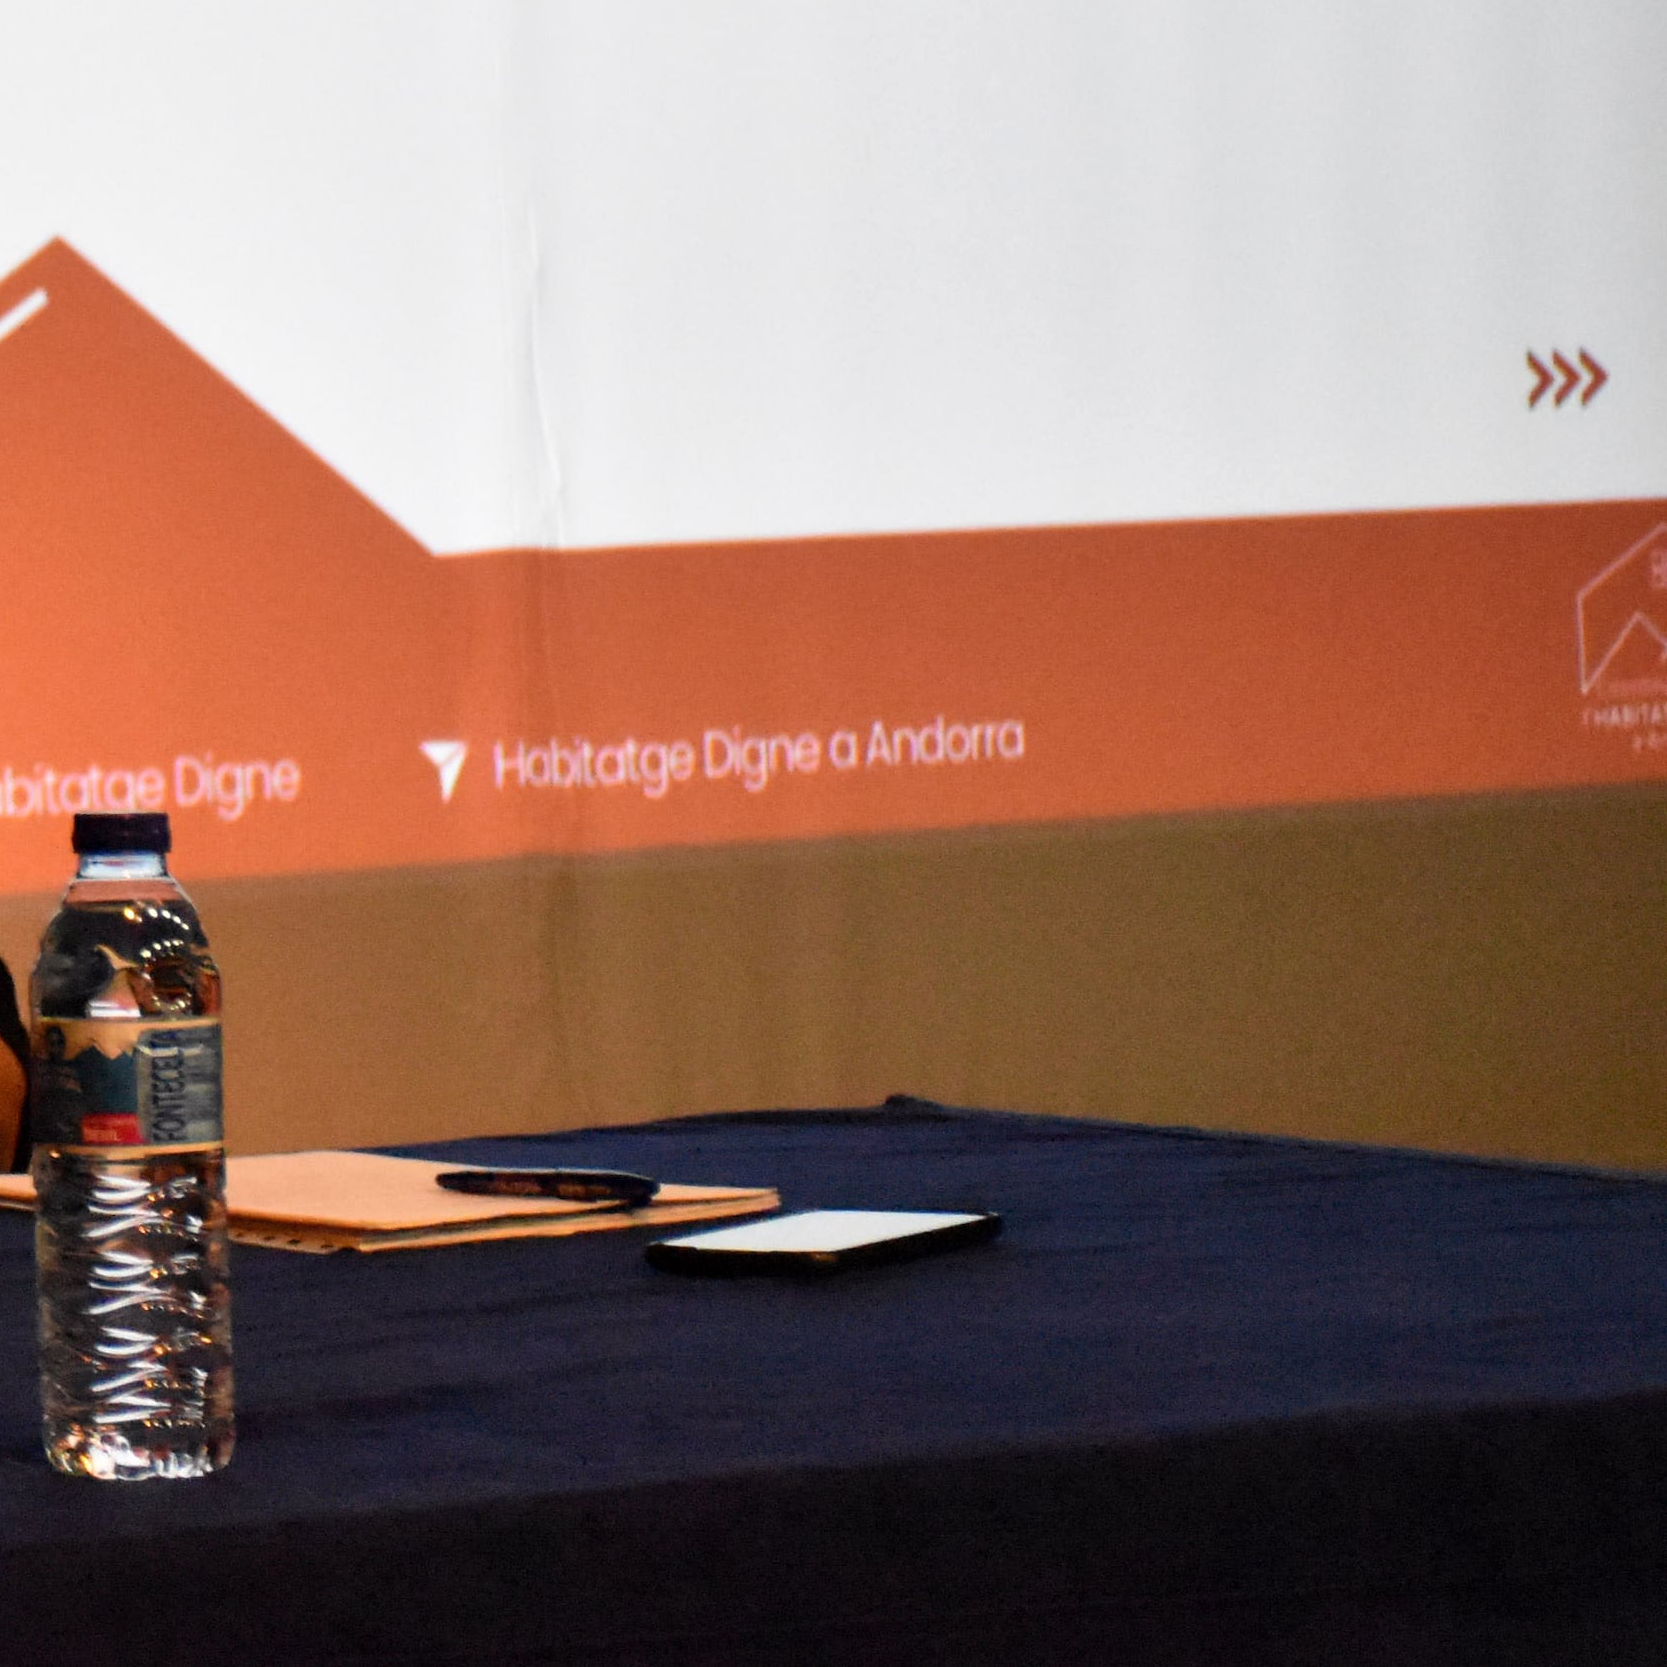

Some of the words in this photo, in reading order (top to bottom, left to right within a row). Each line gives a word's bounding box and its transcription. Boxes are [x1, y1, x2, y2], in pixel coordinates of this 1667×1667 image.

[173, 753, 302, 822] Digne
[492, 735, 696, 800] Habitatge
[701, 725, 822, 793] Digne
[827, 729, 859, 771] a
[866, 714, 1025, 770] Andorra
